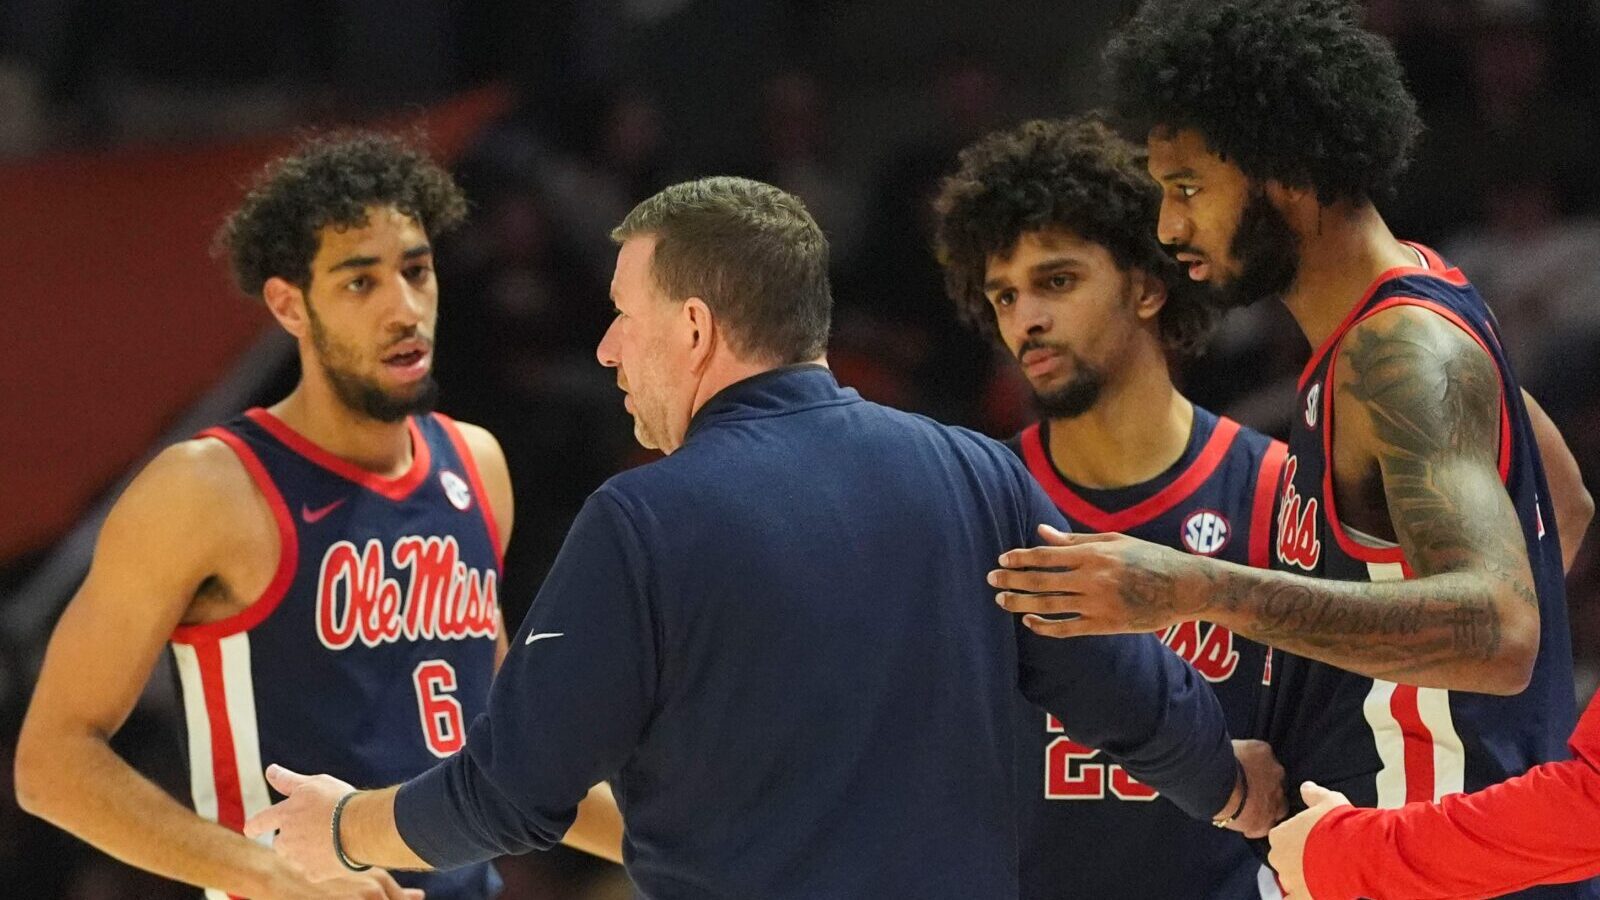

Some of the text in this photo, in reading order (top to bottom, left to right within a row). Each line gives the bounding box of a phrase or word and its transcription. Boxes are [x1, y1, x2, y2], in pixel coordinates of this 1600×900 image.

[1184, 512, 1228, 554] SEC
[316, 535, 501, 650] Ole Miss
[1153, 618, 1241, 683] ss
[412, 659, 467, 759] 6
